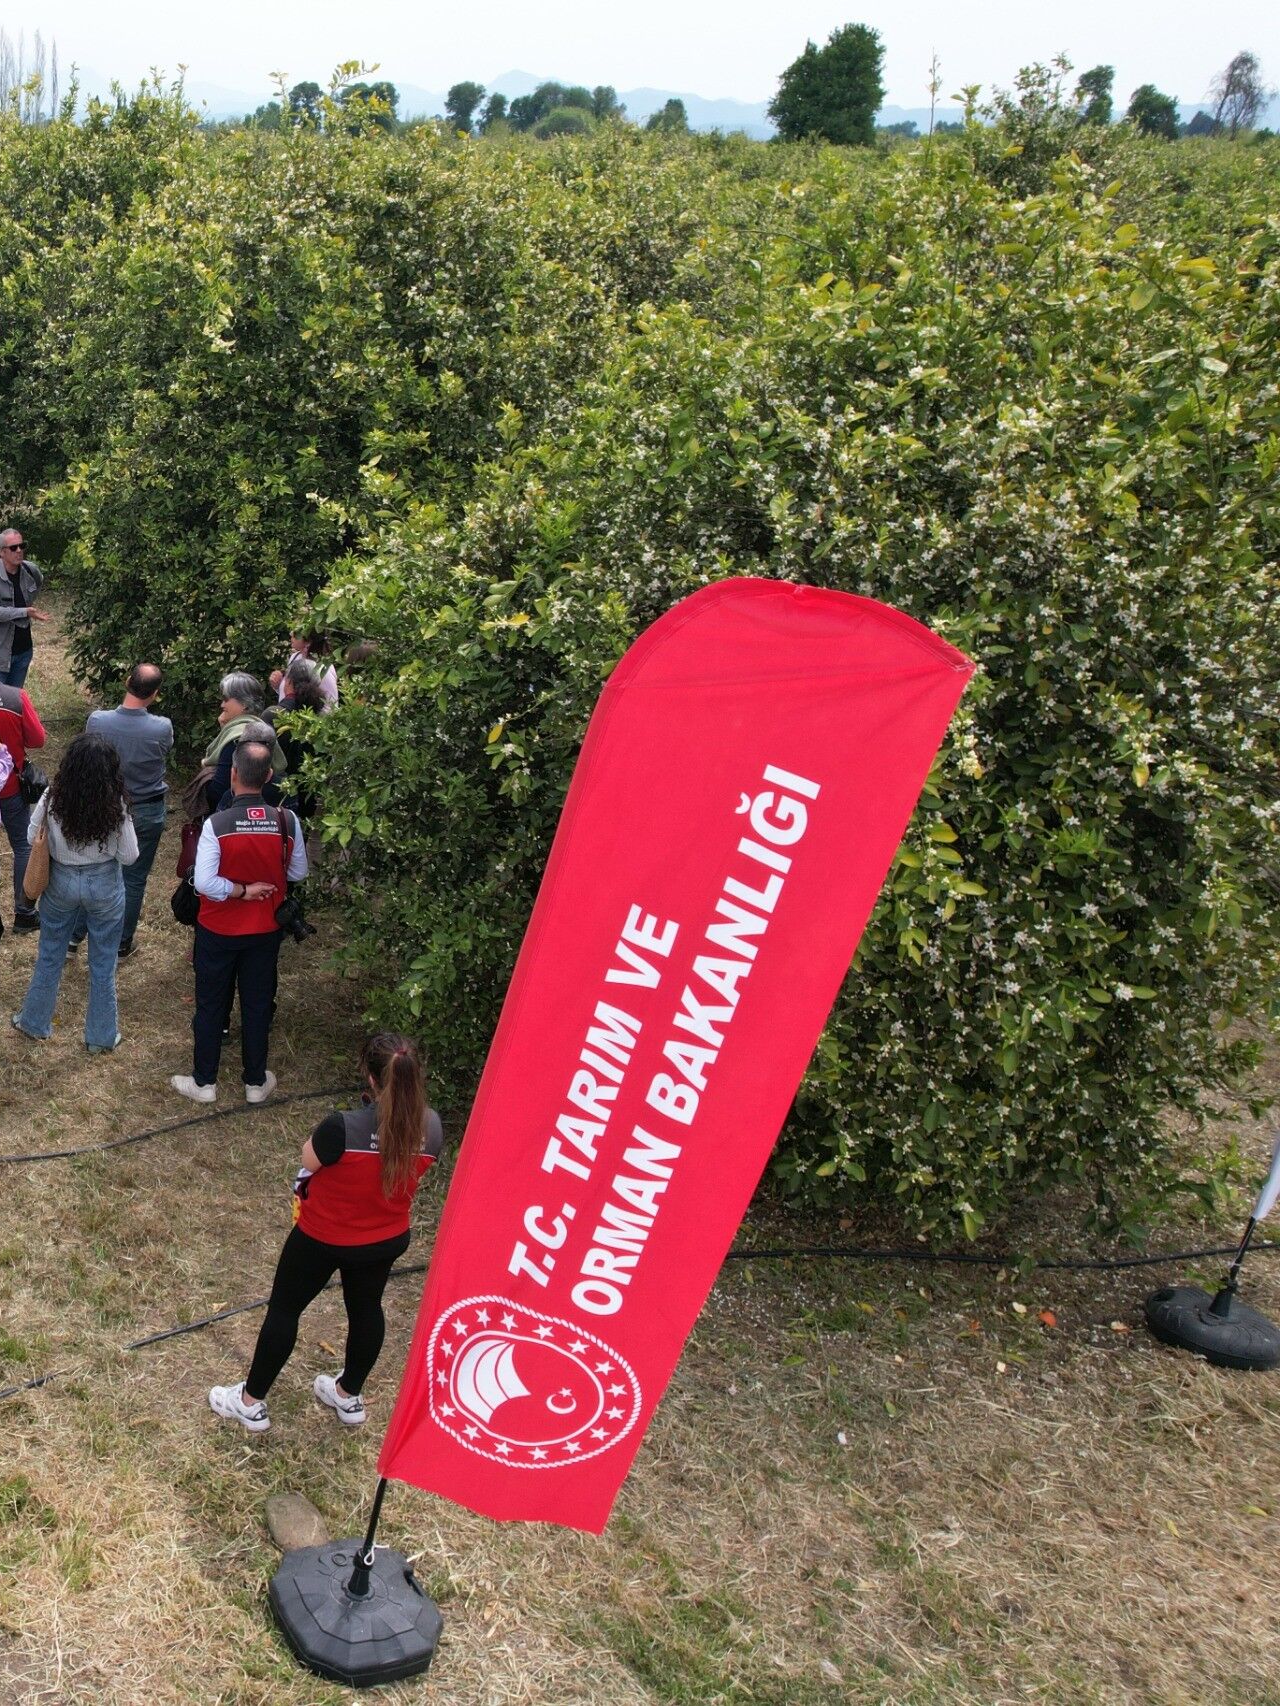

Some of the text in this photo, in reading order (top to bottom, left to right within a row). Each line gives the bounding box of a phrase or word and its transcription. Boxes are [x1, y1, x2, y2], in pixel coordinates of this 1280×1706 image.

[508, 904, 680, 1288] T.C. TARIM VE
[571, 765, 821, 1316] ORMAN BAKANLIĞI
